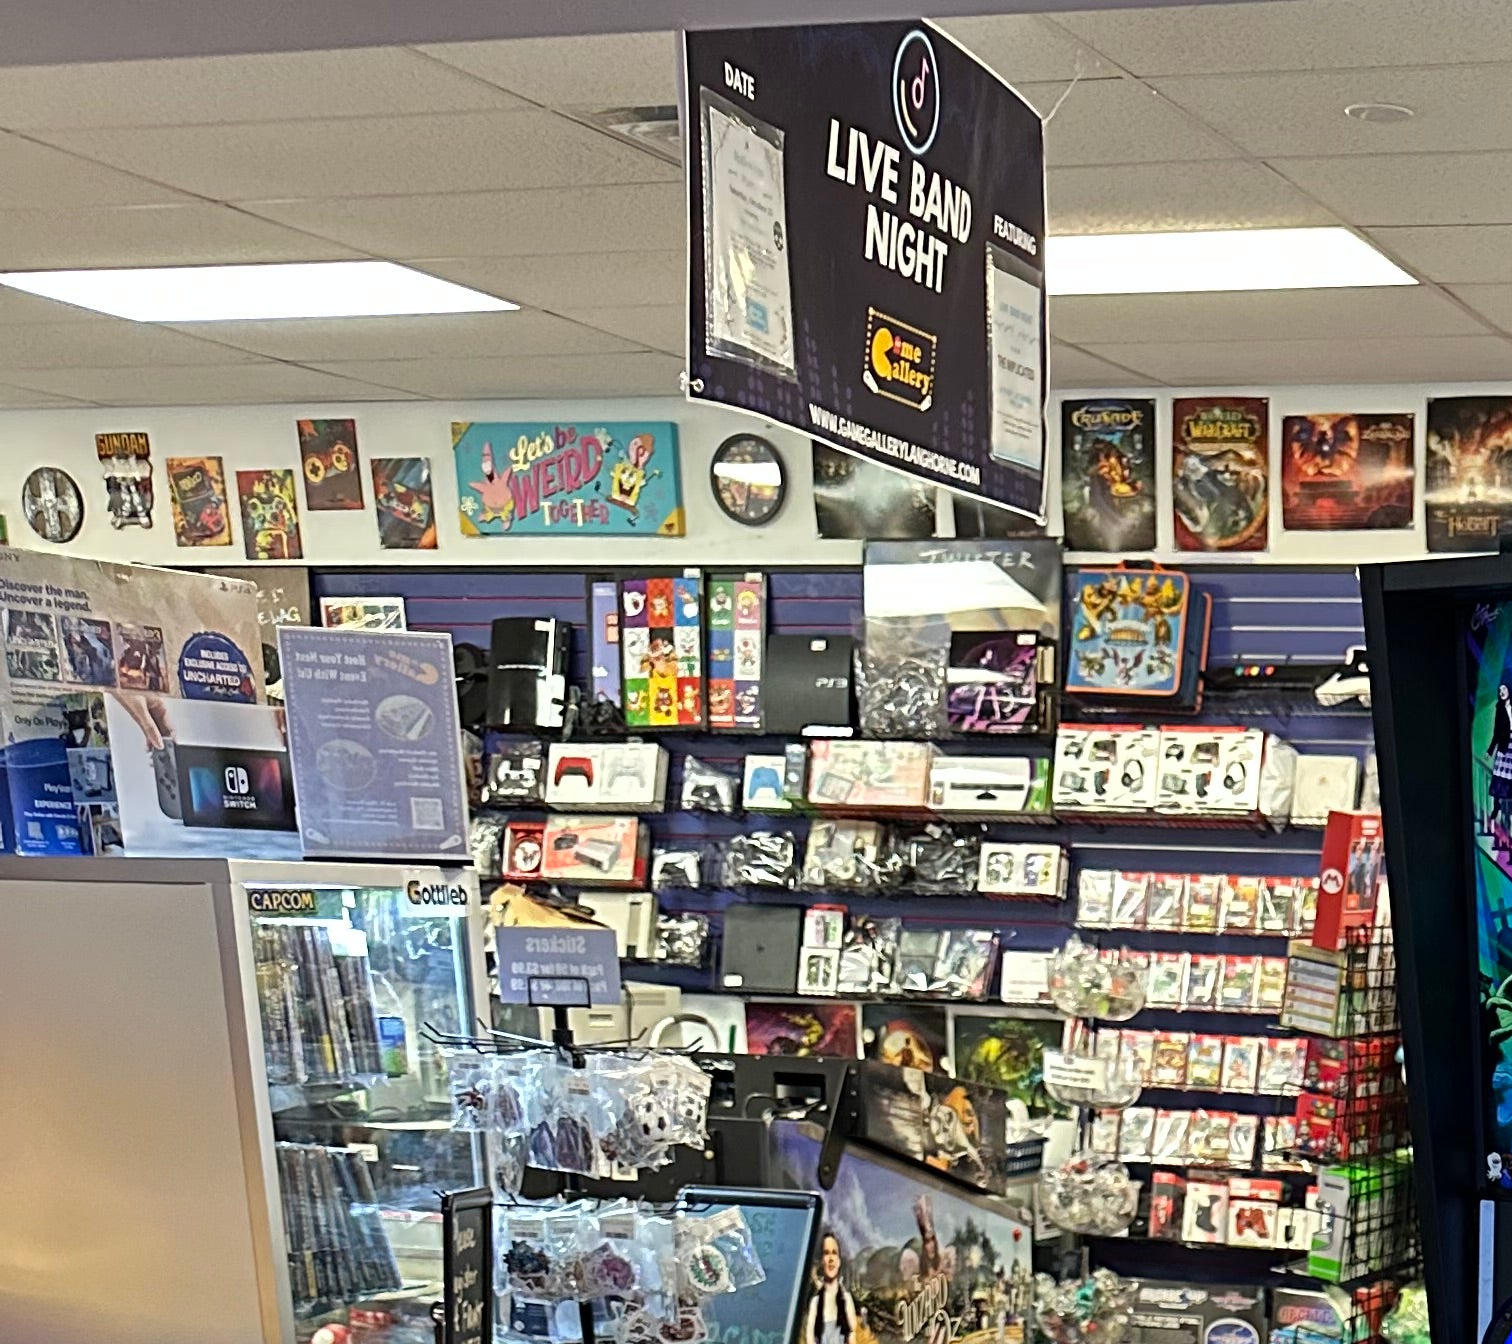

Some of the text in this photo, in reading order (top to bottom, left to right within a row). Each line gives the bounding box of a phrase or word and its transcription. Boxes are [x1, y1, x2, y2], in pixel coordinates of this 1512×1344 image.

[724, 61, 755, 100] DATE
[827, 118, 972, 245] LIVE BAND
[865, 204, 948, 293] NIGHT
[993, 215, 1037, 256] FEATURING
[1188, 421, 1252, 439] WARCRAFT
[97, 434, 149, 457] GUNDAM
[509, 425, 577, 472] Let's be
[539, 498, 610, 527] TOGETHER
[45, 583, 63, 597] the
[182, 669, 241, 687] UNCHARTED
[815, 676, 849, 689] PS3
[223, 800, 257, 810] SWITCH
[250, 892, 316, 912] CAPCOM
[407, 880, 468, 909] Gottlieb
